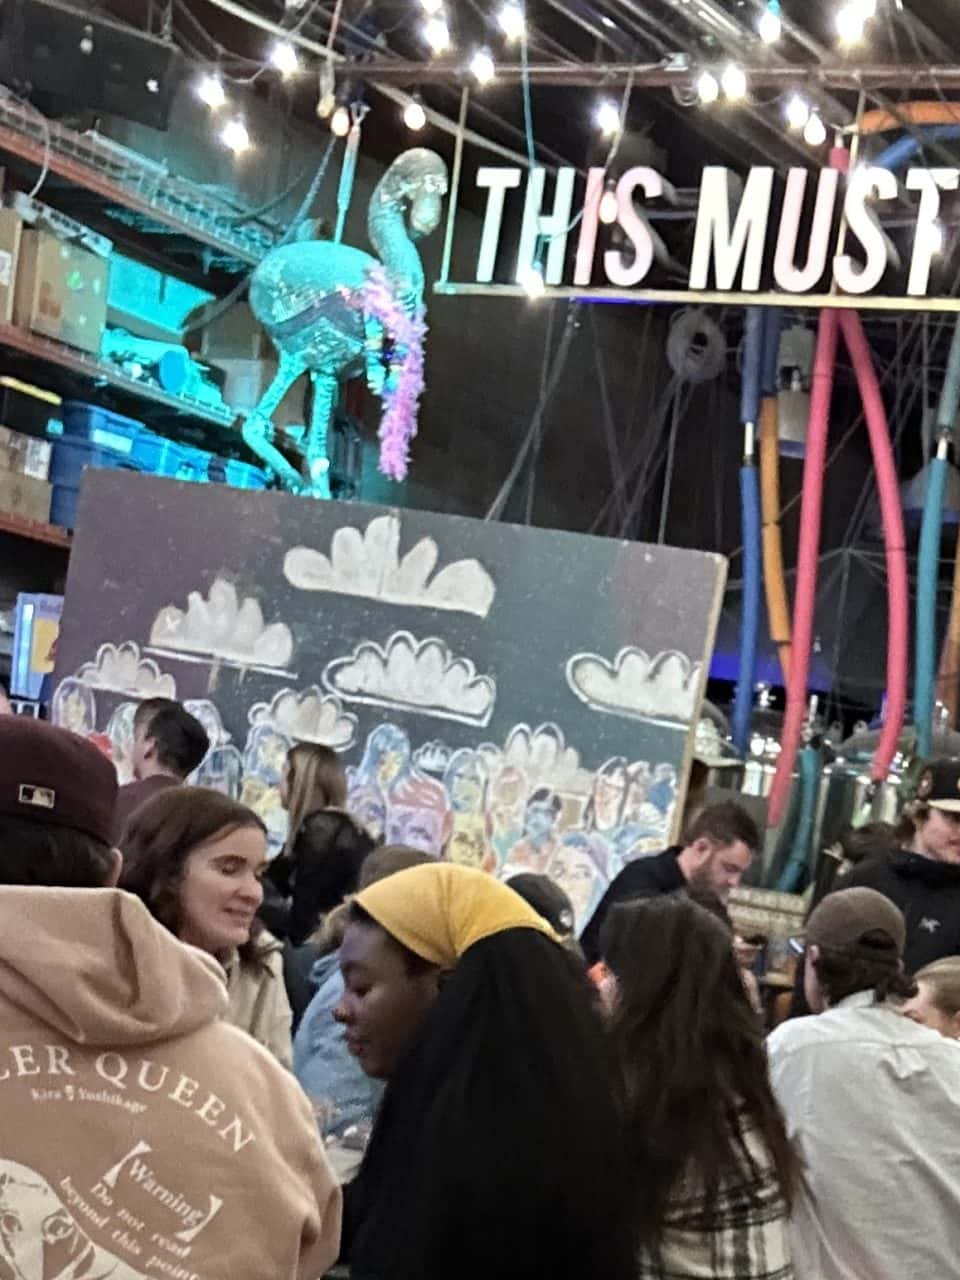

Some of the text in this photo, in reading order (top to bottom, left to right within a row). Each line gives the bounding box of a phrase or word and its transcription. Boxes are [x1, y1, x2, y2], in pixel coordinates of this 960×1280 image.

[474, 165, 662, 287] THIS
[689, 164, 959, 294] MUST
[95, 1051, 256, 1152] QUEEN
